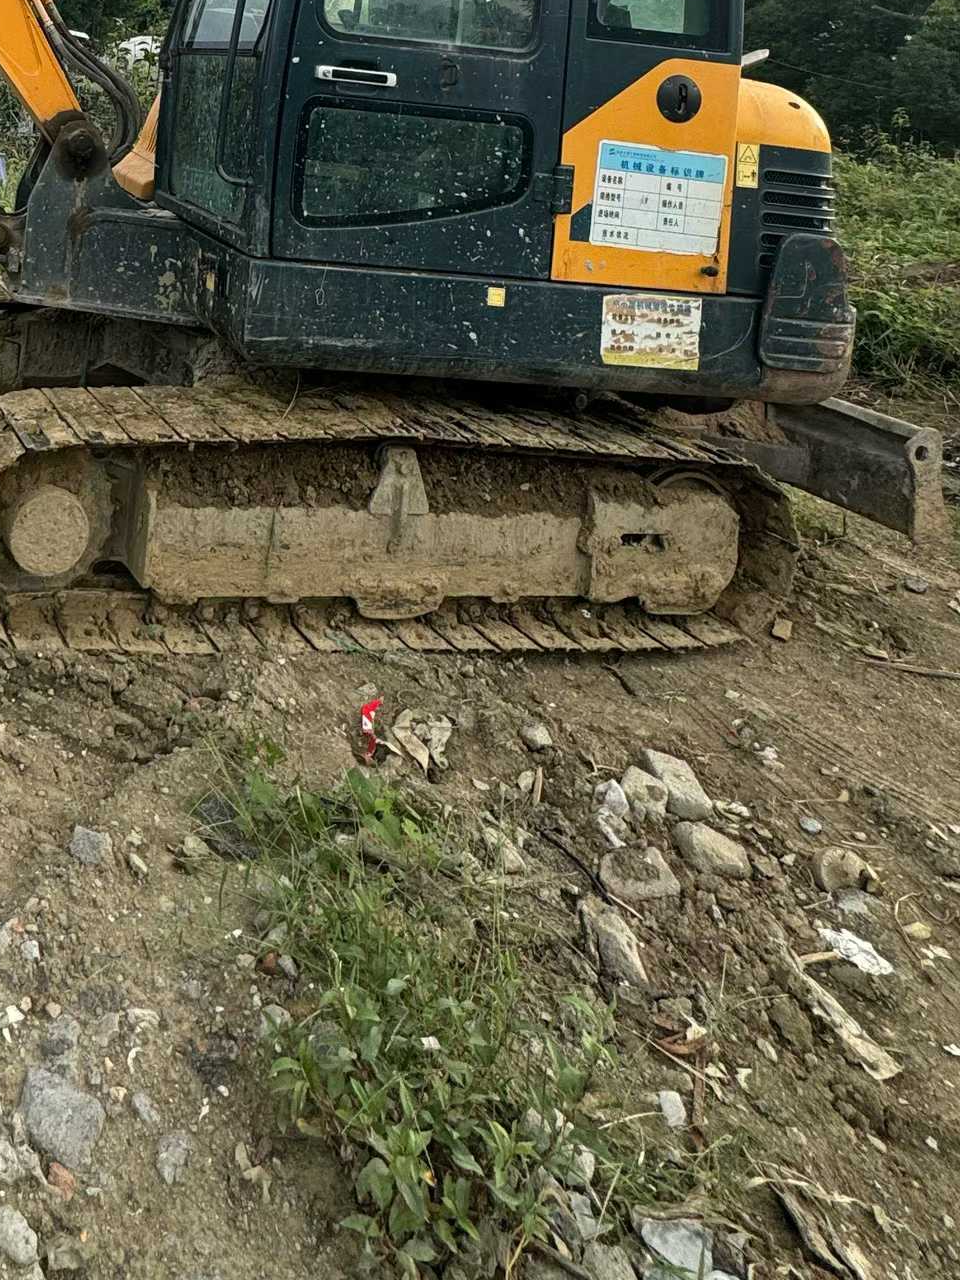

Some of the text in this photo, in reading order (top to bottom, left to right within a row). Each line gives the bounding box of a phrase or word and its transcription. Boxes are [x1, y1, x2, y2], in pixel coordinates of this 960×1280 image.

[620, 160, 705, 179] 机械设备标识牌
